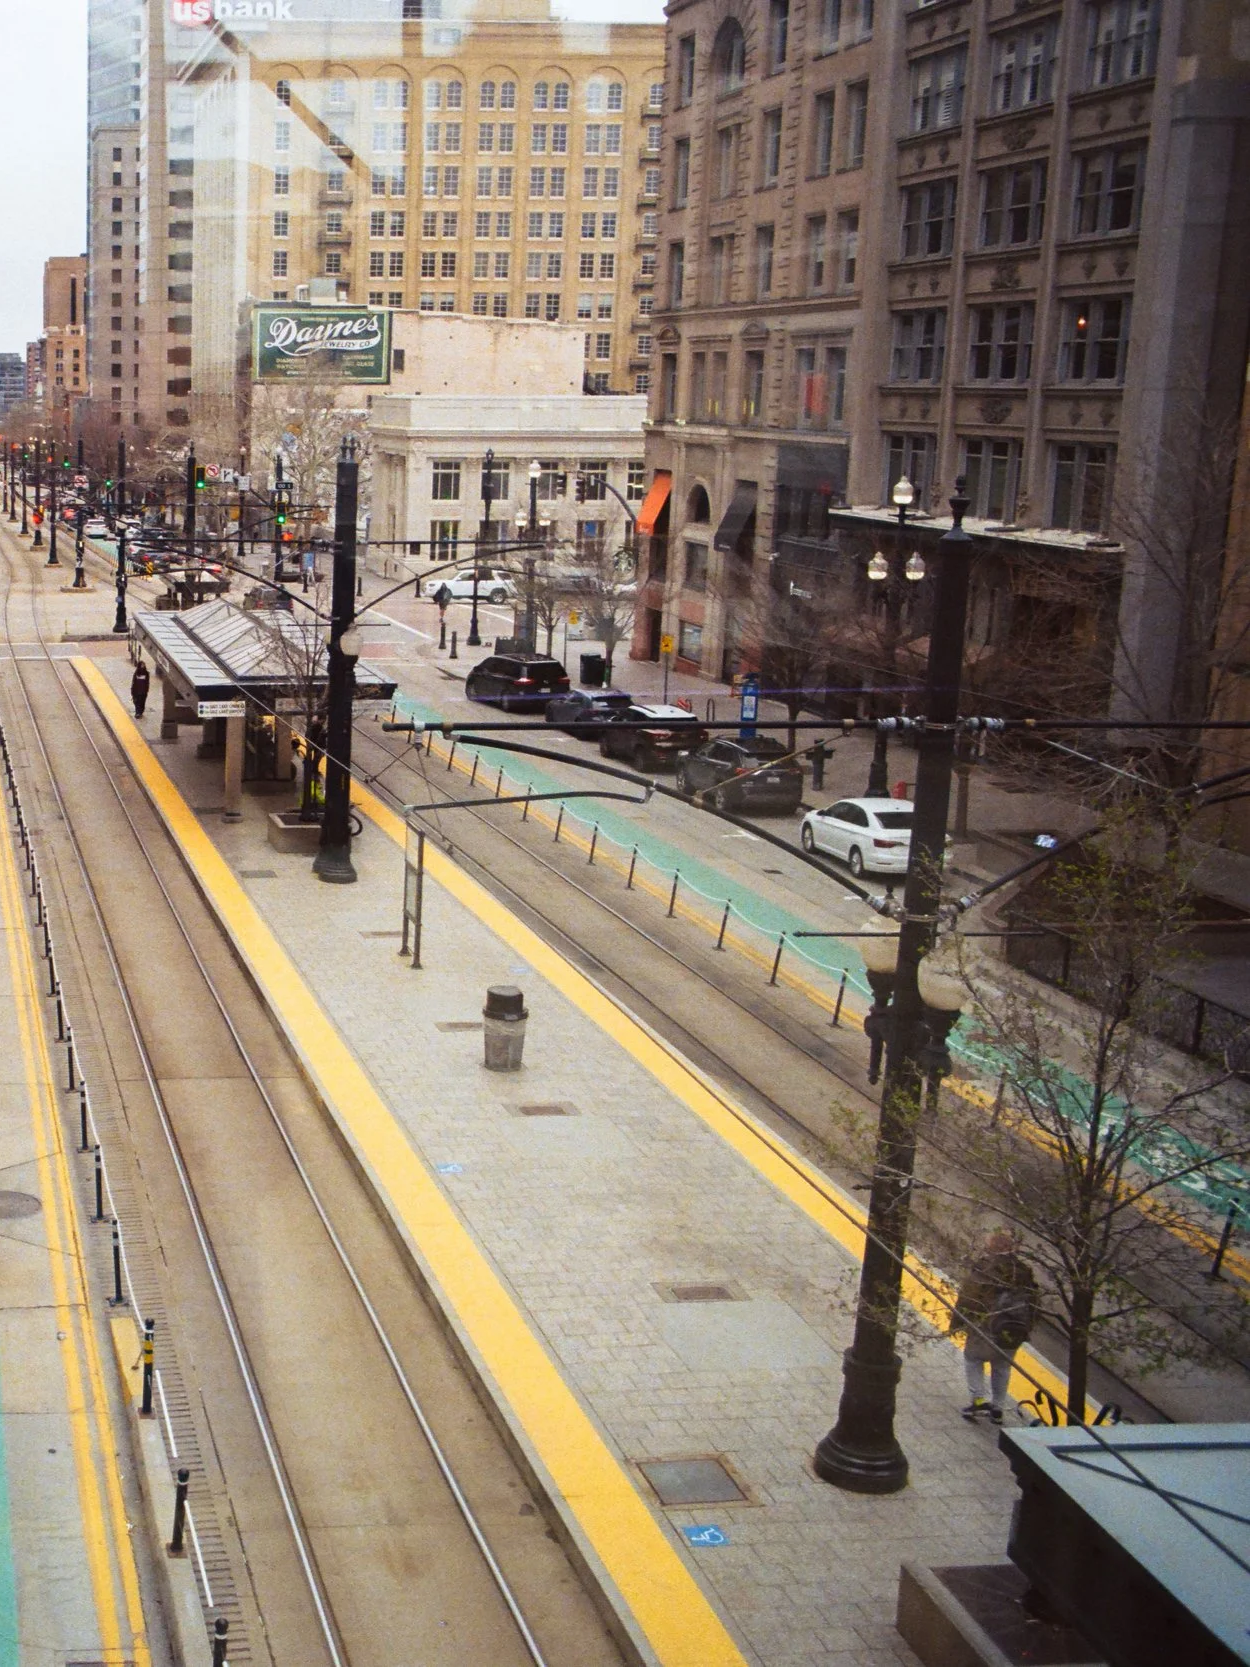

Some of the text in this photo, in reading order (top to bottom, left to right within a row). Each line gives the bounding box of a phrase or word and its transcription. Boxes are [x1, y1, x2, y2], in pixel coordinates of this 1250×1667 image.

[173, 0, 293, 20] us bank
[264, 315, 381, 356] Daynes
